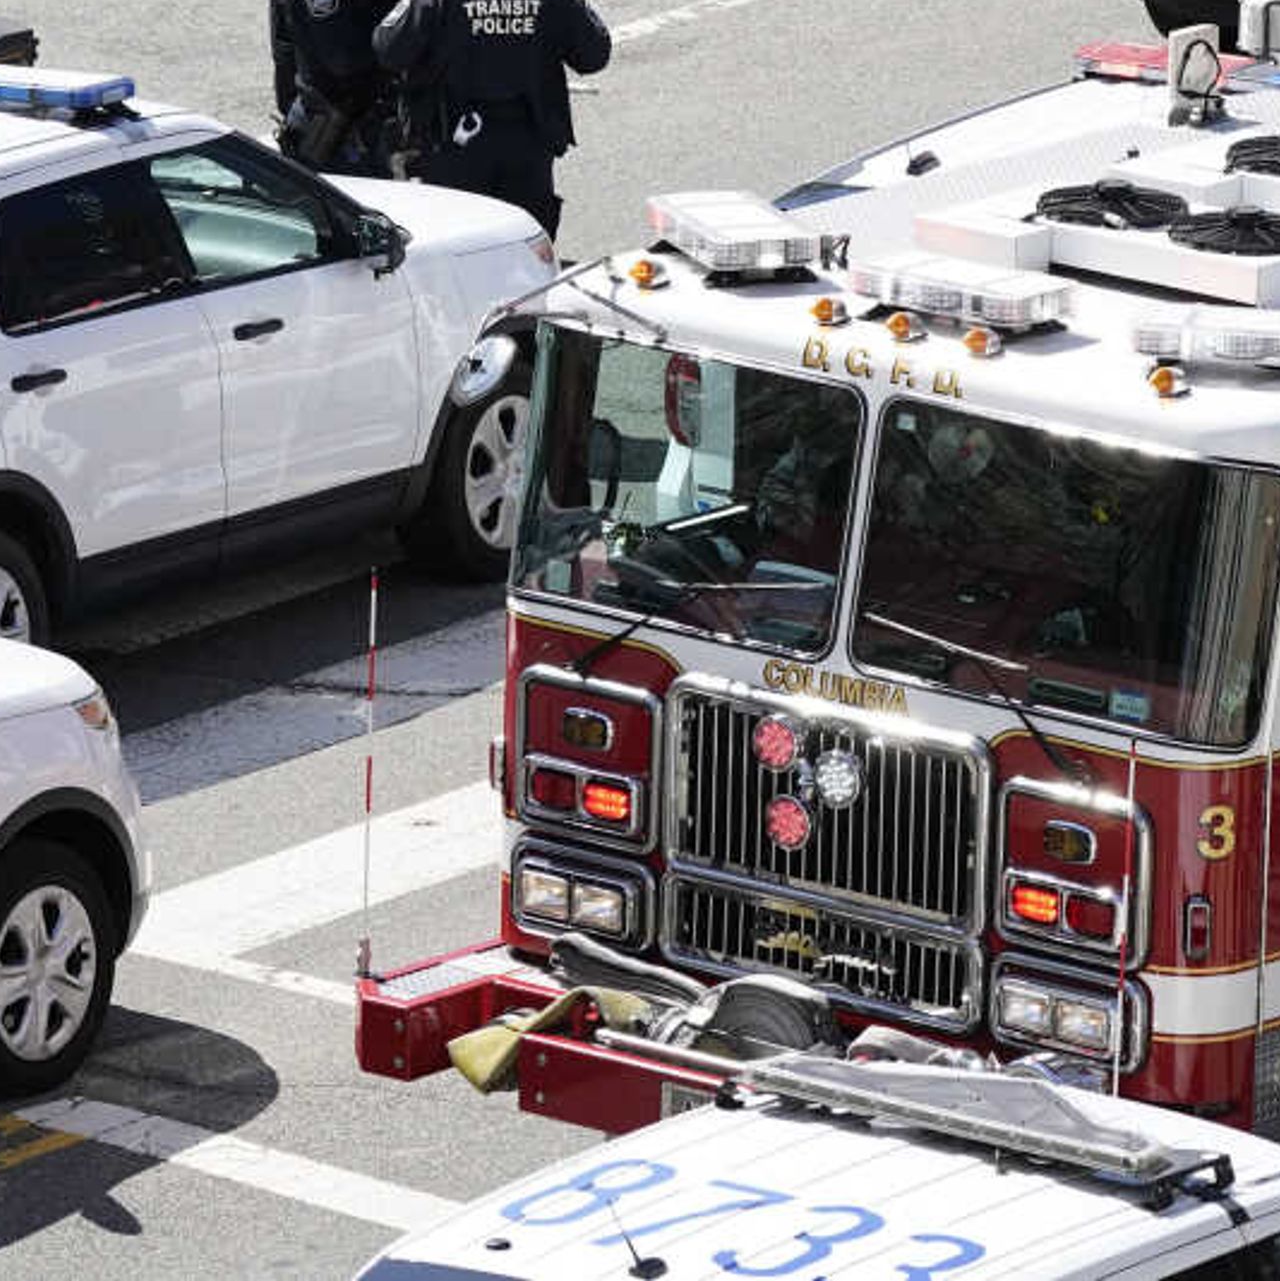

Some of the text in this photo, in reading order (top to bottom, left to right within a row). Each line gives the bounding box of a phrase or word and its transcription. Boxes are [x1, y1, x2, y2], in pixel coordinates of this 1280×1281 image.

[462, 0, 541, 18] TRANSIT
[472, 17, 535, 36] POLICE
[763, 659, 909, 718] COLUMBIA
[1197, 804, 1236, 860] 3
